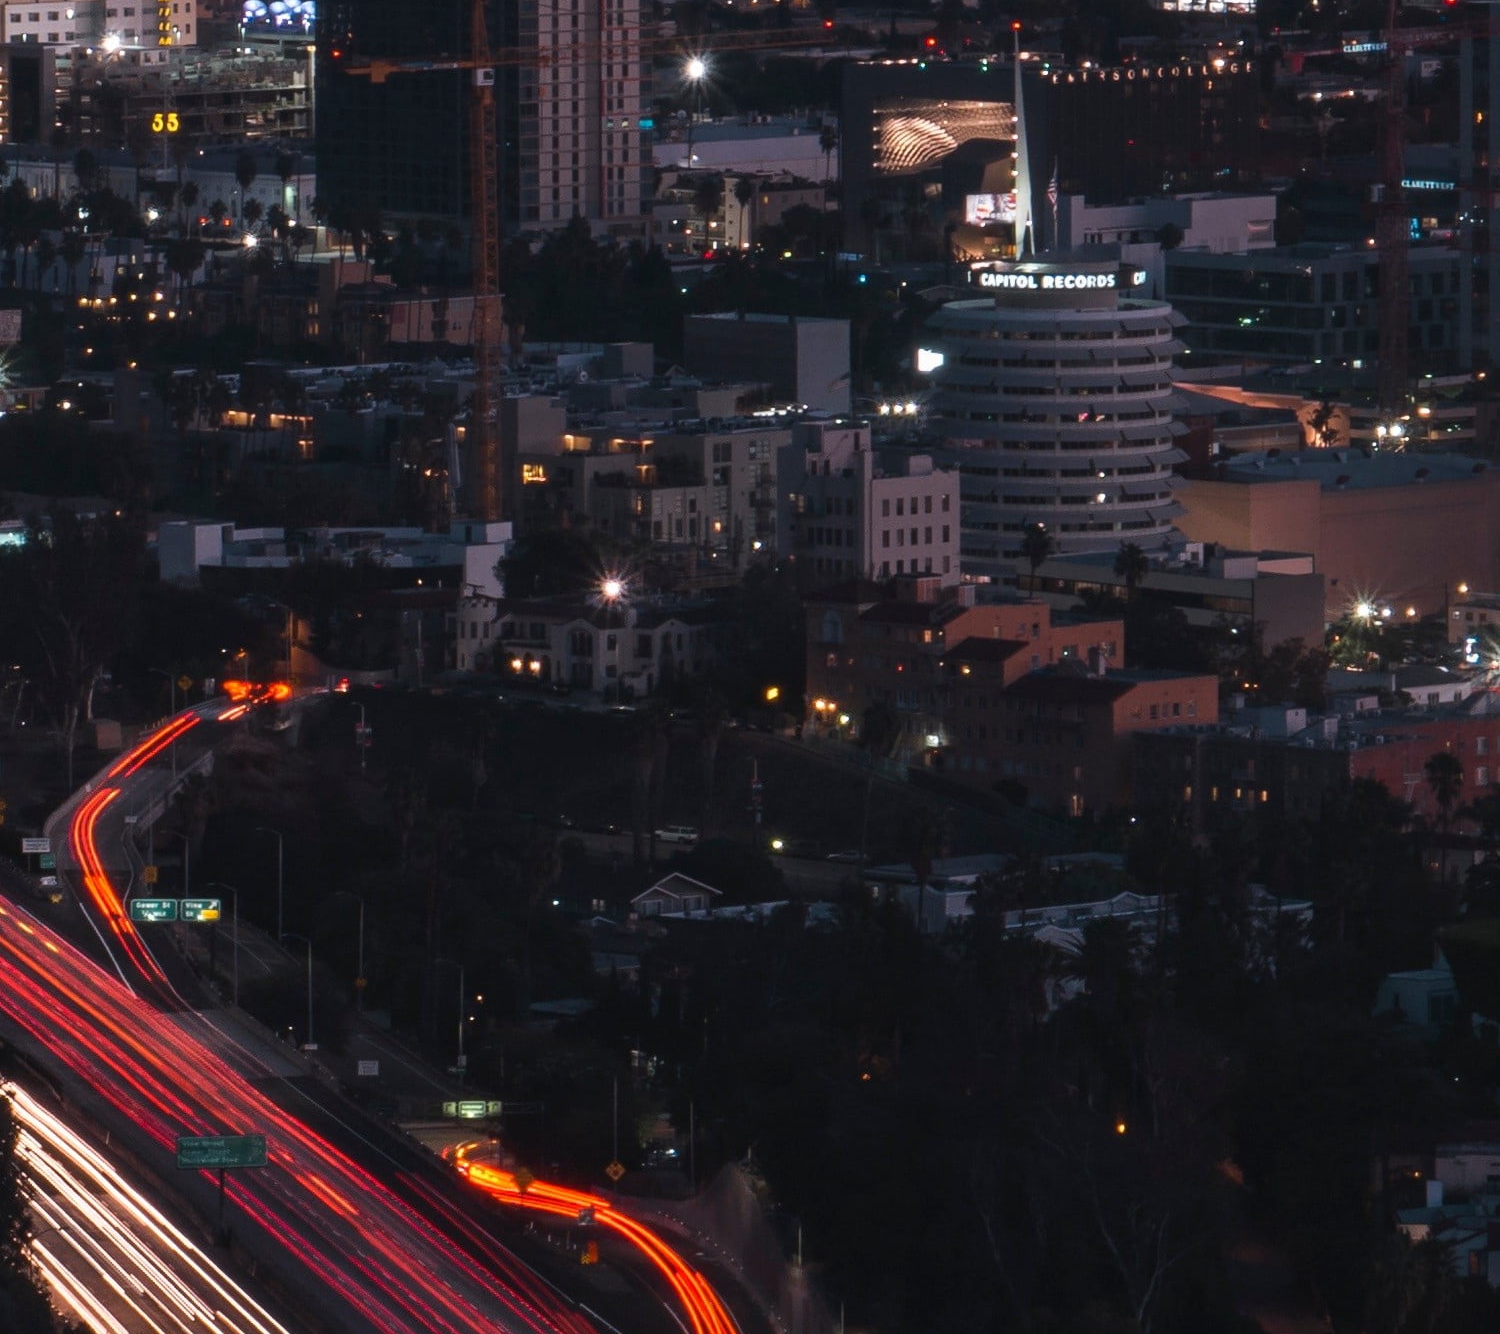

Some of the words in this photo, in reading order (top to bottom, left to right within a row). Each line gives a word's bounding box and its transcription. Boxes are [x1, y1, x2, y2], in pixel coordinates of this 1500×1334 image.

[980, 273, 1038, 289] CAPITOL
[1042, 274, 1116, 289] RECORDS
[136, 901, 160, 909] Gower
[161, 901, 171, 909] St
